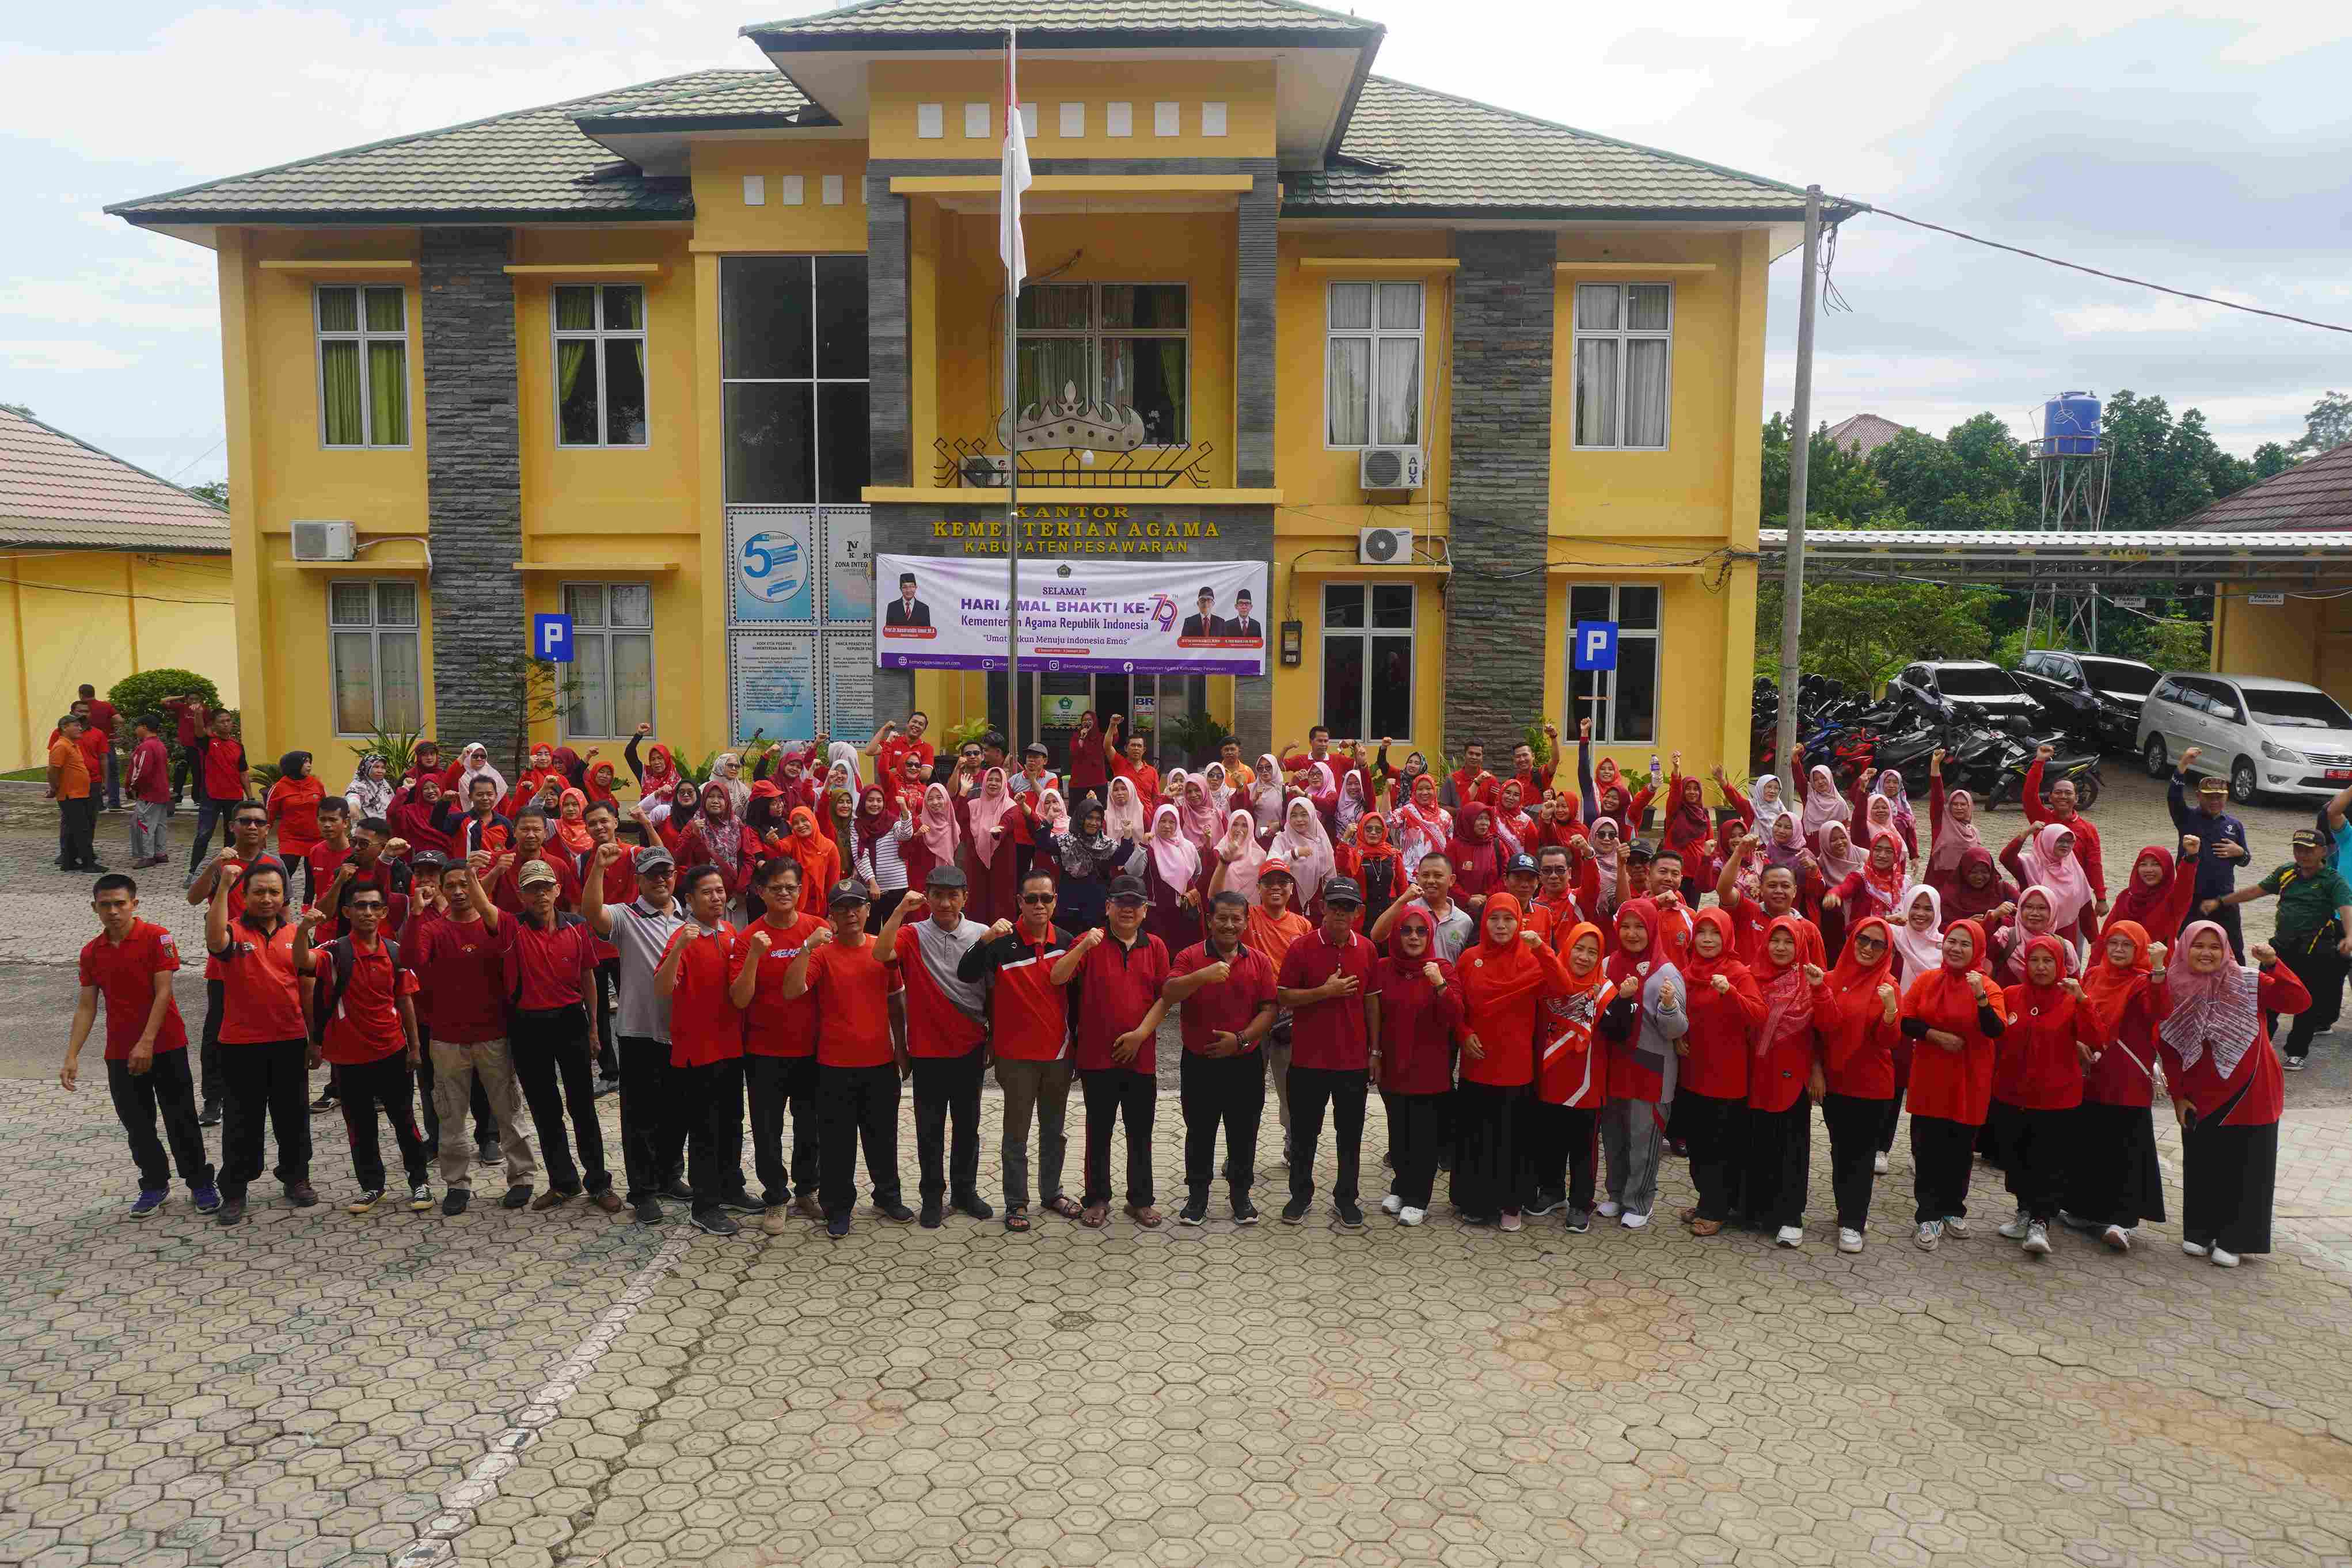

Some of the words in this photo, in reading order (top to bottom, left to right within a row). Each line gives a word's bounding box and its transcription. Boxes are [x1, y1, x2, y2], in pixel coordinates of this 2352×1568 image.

[1408, 457, 1418, 484] AUX
[1016, 506, 1129, 517] KANTOR
[1127, 522, 1220, 536] AGAMA
[964, 541, 1068, 553] KABUPATEN
[1074, 541, 1188, 553] PESAWARAN
[1042, 586, 1087, 596] SELAMAT
[960, 597, 1000, 610] HARI
[1055, 601, 1118, 613] BHAKTI
[961, 615, 1021, 627] Kementern
[1025, 616, 1057, 630] Agama
[1059, 618, 1100, 631] Republik
[1103, 619, 1149, 630] Indonesia
[544, 623, 563, 653] P
[1036, 636, 1065, 645] Menuju
[1067, 636, 1105, 645] Indonesia
[1586, 630, 1607, 661] P
